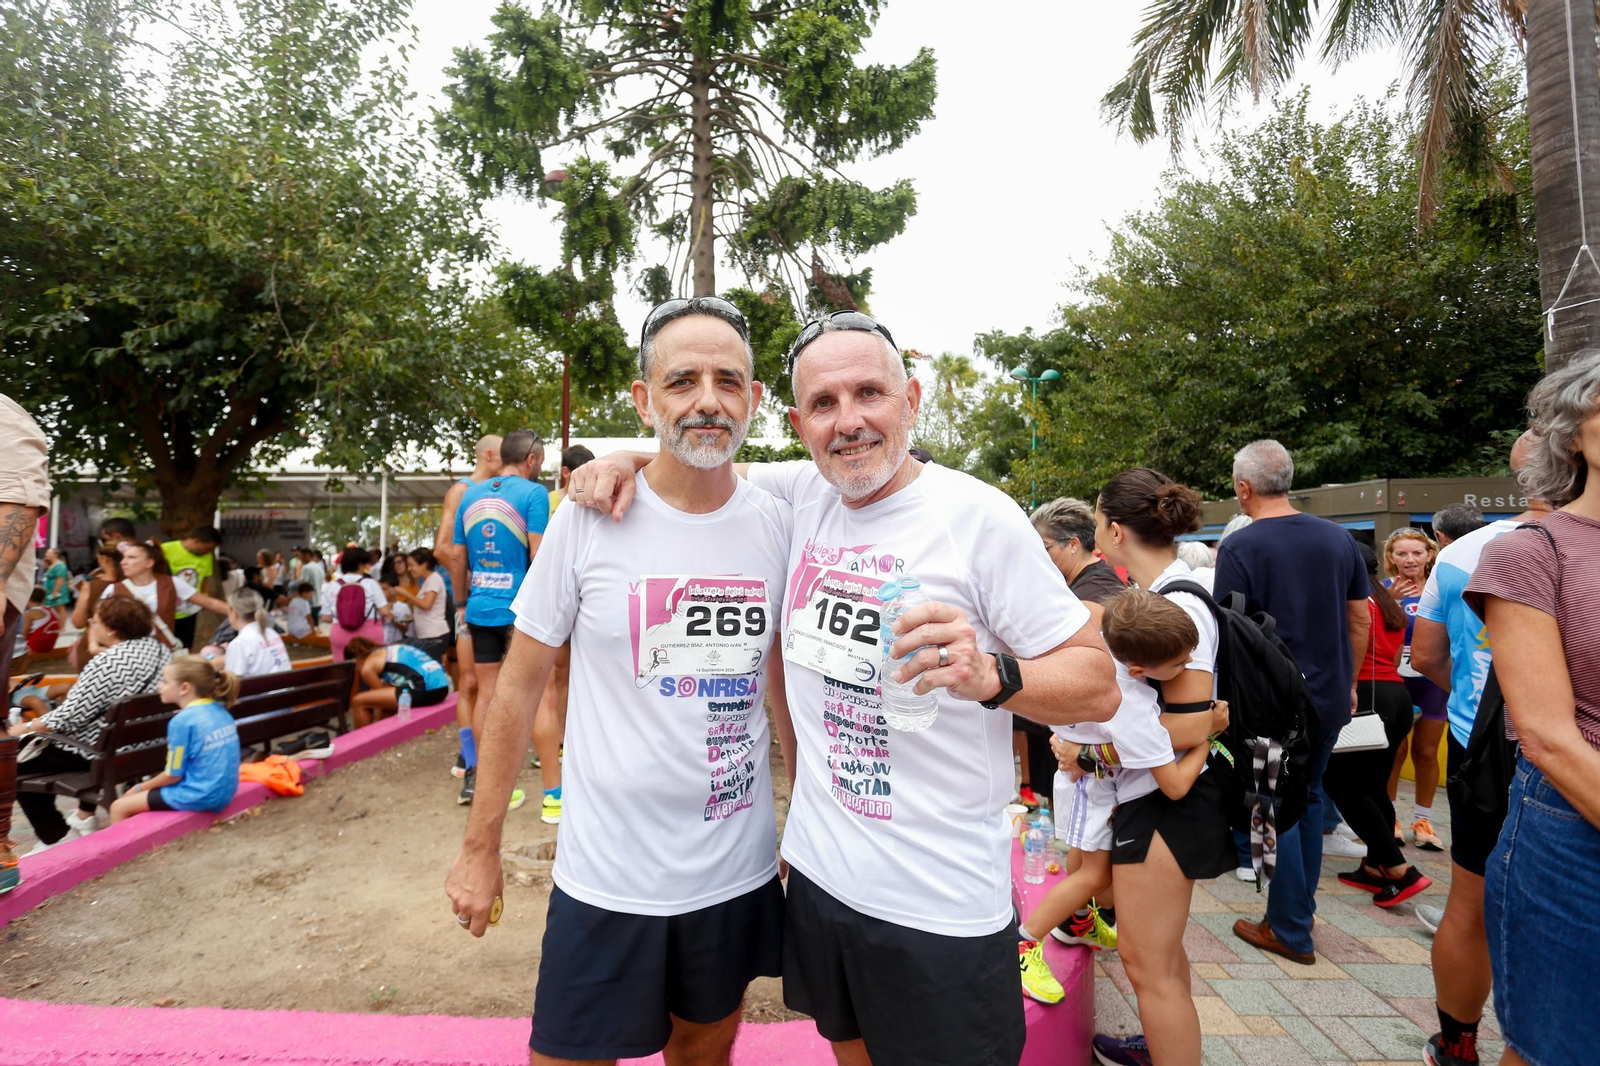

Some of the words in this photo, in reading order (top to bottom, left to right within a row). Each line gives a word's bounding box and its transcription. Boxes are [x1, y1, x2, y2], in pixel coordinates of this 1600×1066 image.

[1464, 494, 1529, 508] Resta
[686, 605, 767, 637] 269
[815, 598, 881, 647] 162
[823, 639, 846, 651] FRANCISCO
[848, 653, 864, 661] MASTER
[659, 676, 758, 698] SONRISA
[823, 720, 888, 747] Deporte
[707, 740, 755, 764] Deporte
